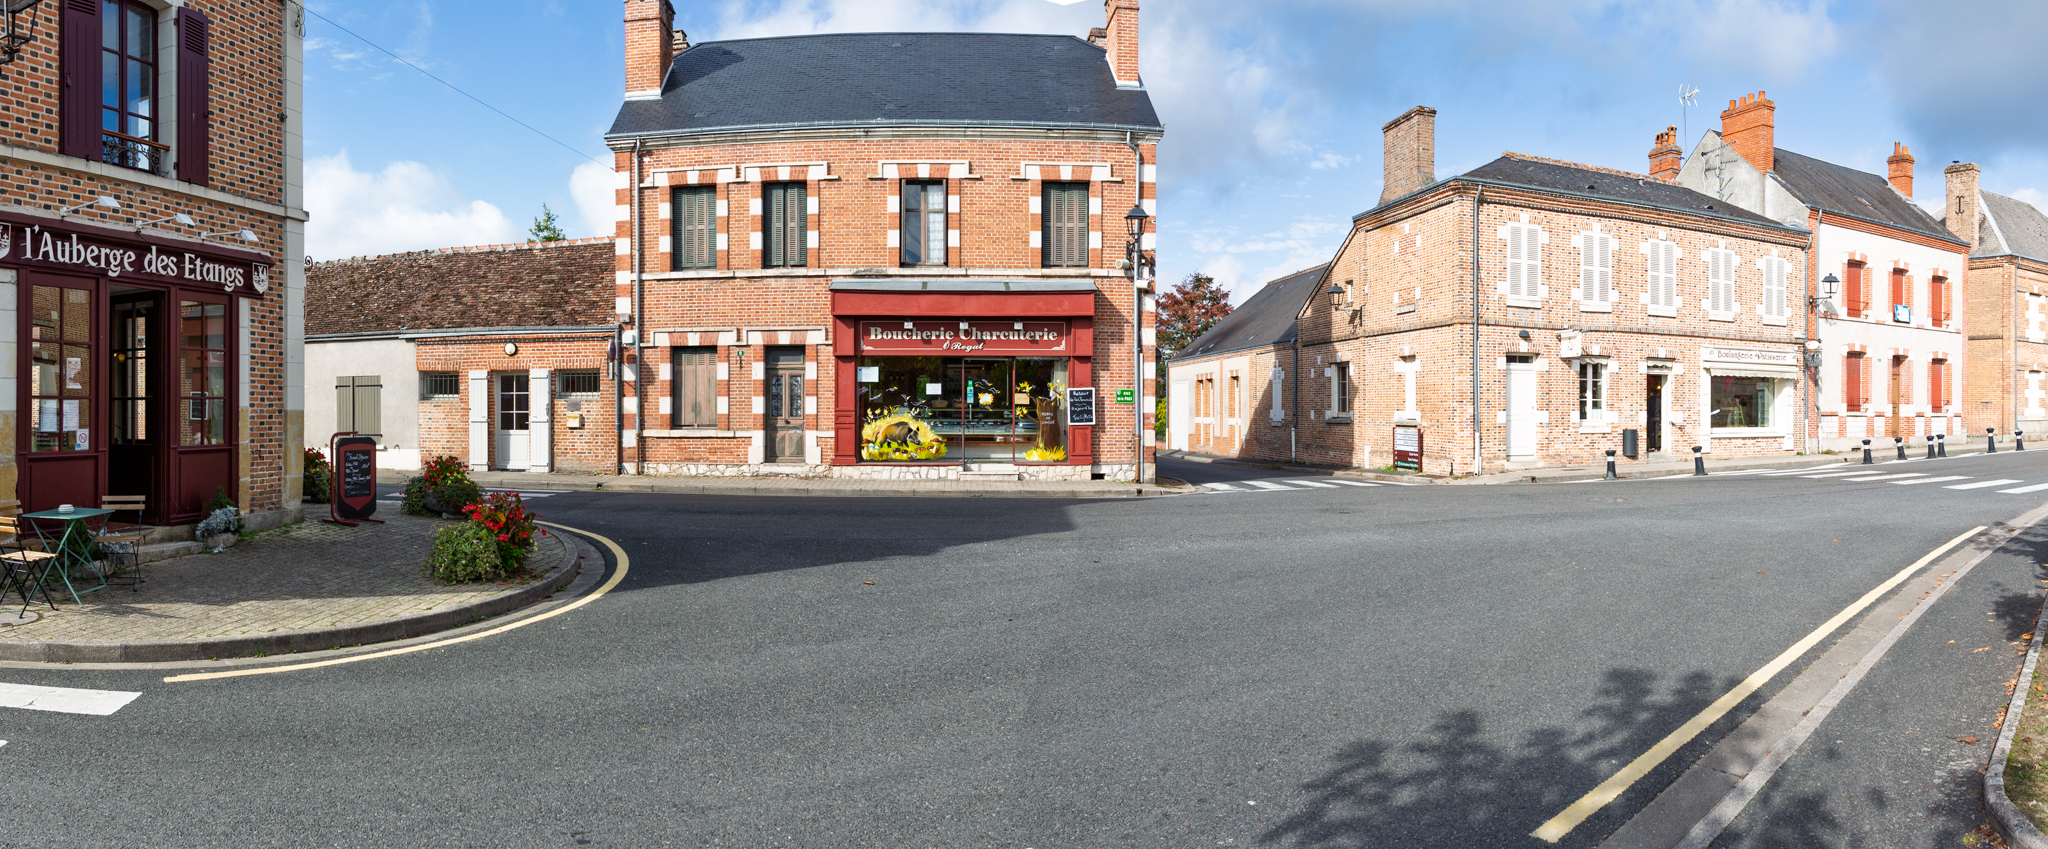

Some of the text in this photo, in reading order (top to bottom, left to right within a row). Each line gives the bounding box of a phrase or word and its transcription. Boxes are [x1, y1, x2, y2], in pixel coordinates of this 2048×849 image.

[22, 224, 245, 293] l'Auberge des Etangs
[868, 326, 1058, 342] Boucherie Charcuterie
[1717, 350, 1754, 361] Boulangerie
